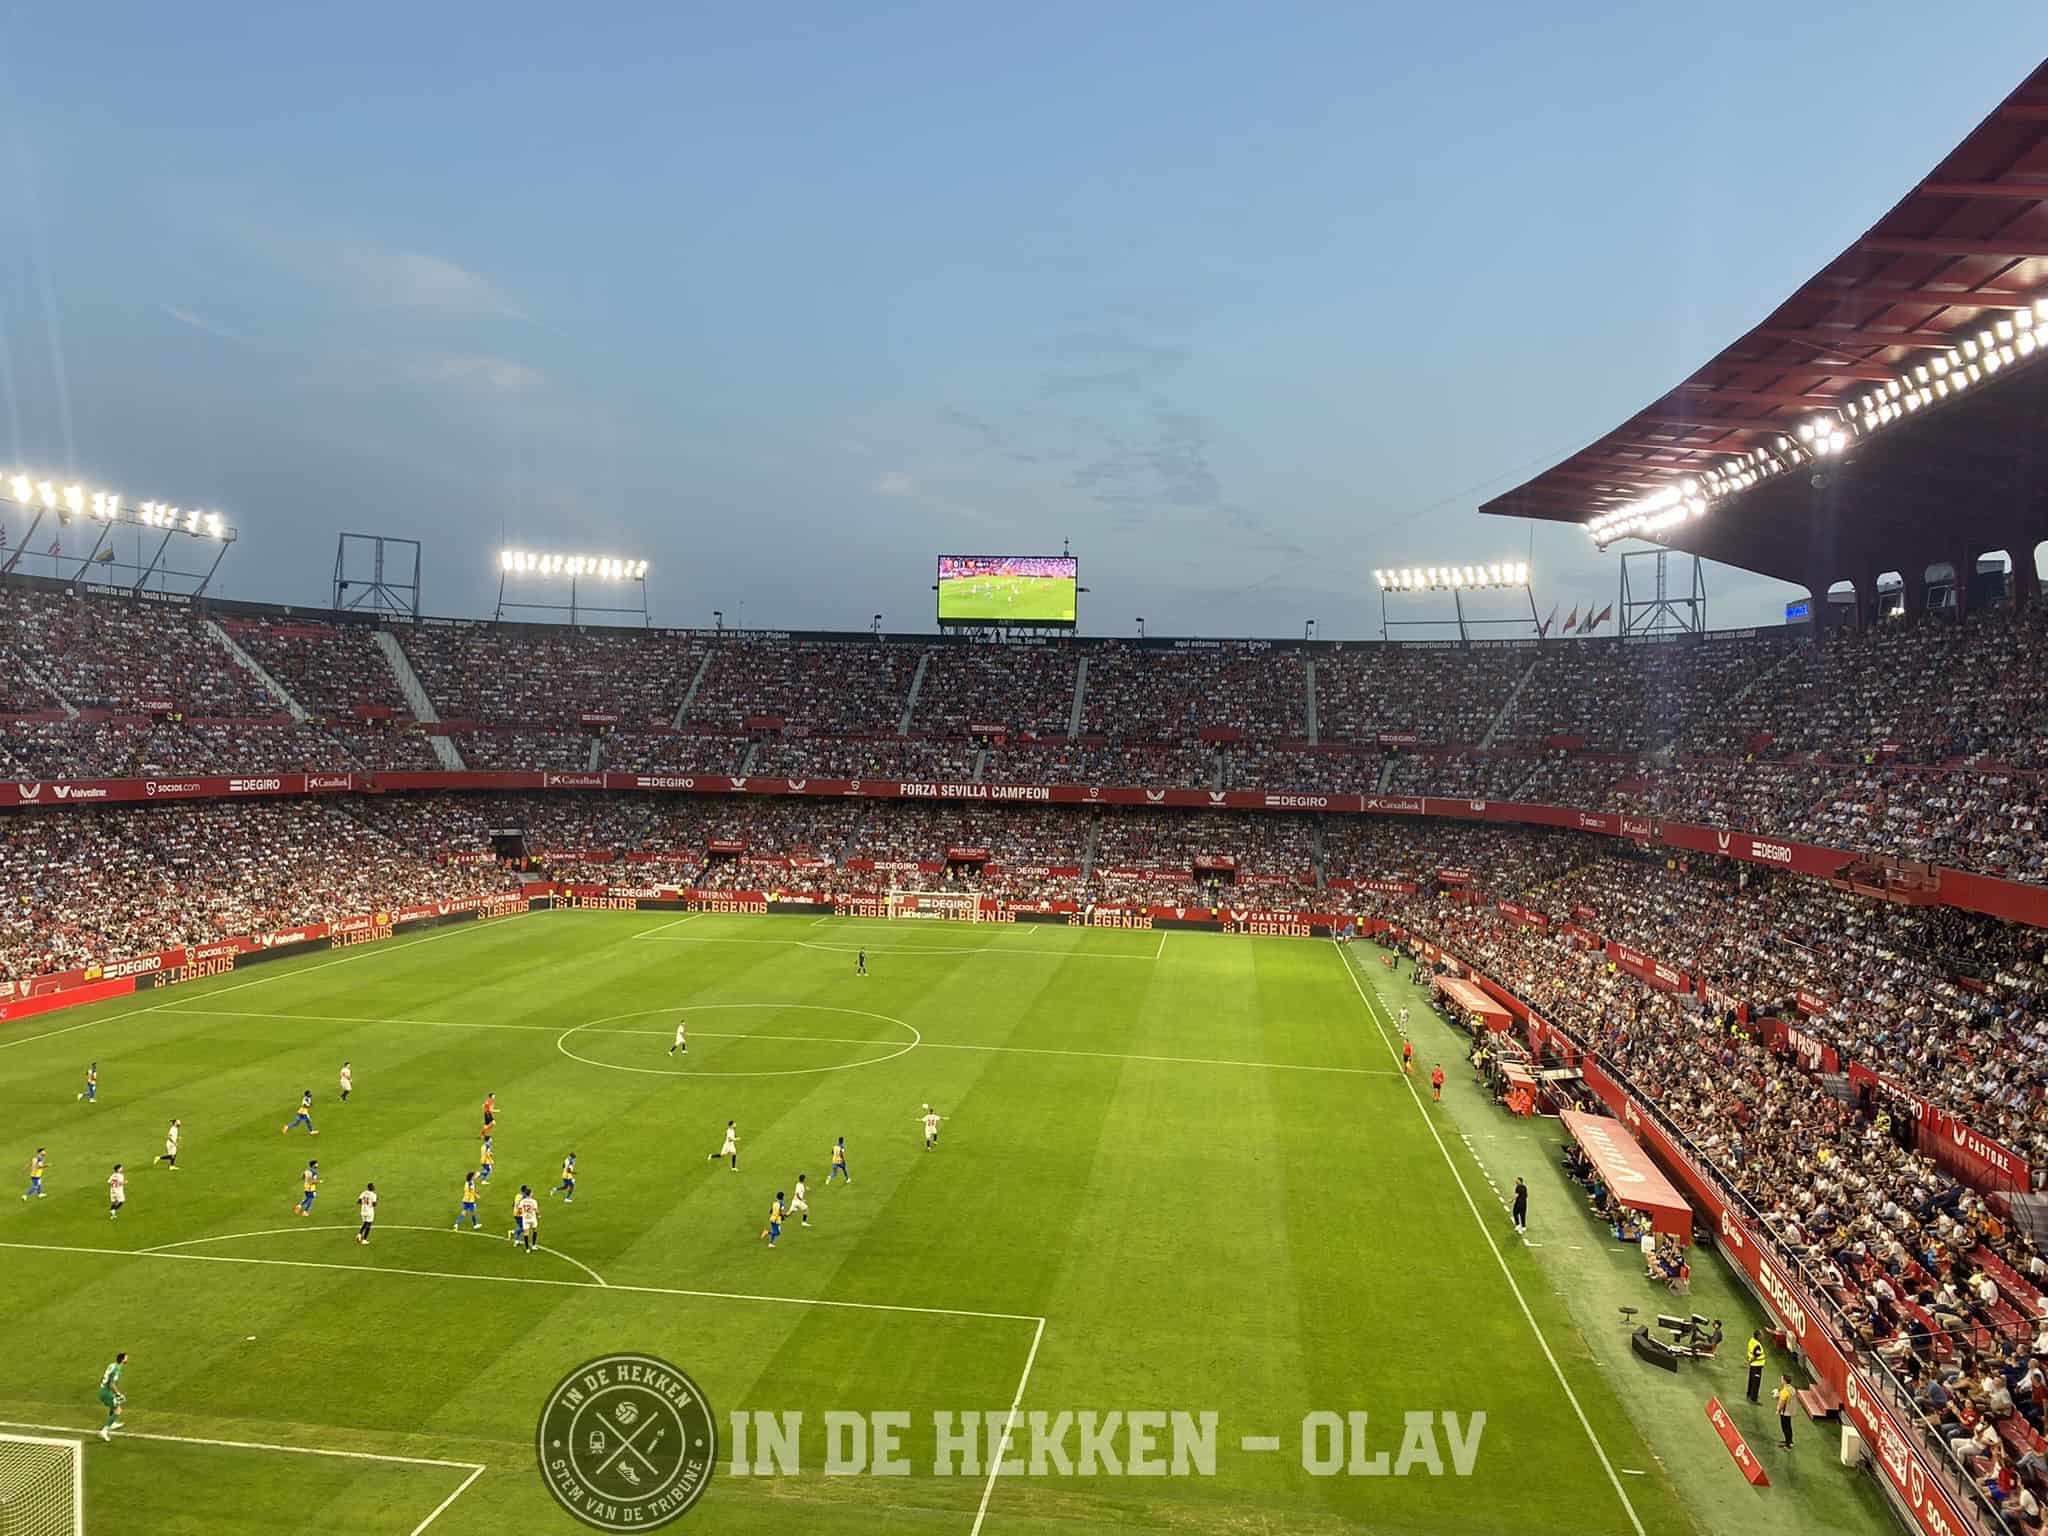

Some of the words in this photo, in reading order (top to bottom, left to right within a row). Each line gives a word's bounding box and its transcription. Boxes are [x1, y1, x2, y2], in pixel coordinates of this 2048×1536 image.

[243, 779, 280, 791] DEGIRO
[651, 777, 694, 788] DEGIRO
[900, 783, 937, 796] FORZA
[941, 784, 987, 798] SEVILLA
[992, 785, 1049, 799] CAMPEON
[1281, 796, 1328, 807] DEGIRO
[1762, 843, 1791, 863] DEGIRO
[885, 862, 919, 871] DEGIRO
[622, 887, 661, 899] DEGIRO
[487, 899, 529, 918] LEGENDS
[572, 896, 637, 911] LEGENDS
[702, 901, 768, 914] LEGENDS
[932, 899, 972, 909] DEGIRO
[949, 908, 1016, 923] LEGENDS
[1084, 914, 1153, 929] LEGENDS
[344, 924, 393, 947] LEGENDS
[1240, 921, 1311, 937] LEGENDS
[118, 956, 162, 976] DEGIRO
[170, 955, 234, 985] LEGENDS
[1968, 1136, 2010, 1172] CASTORE
[1770, 1271, 1807, 1338] DEGIRO
